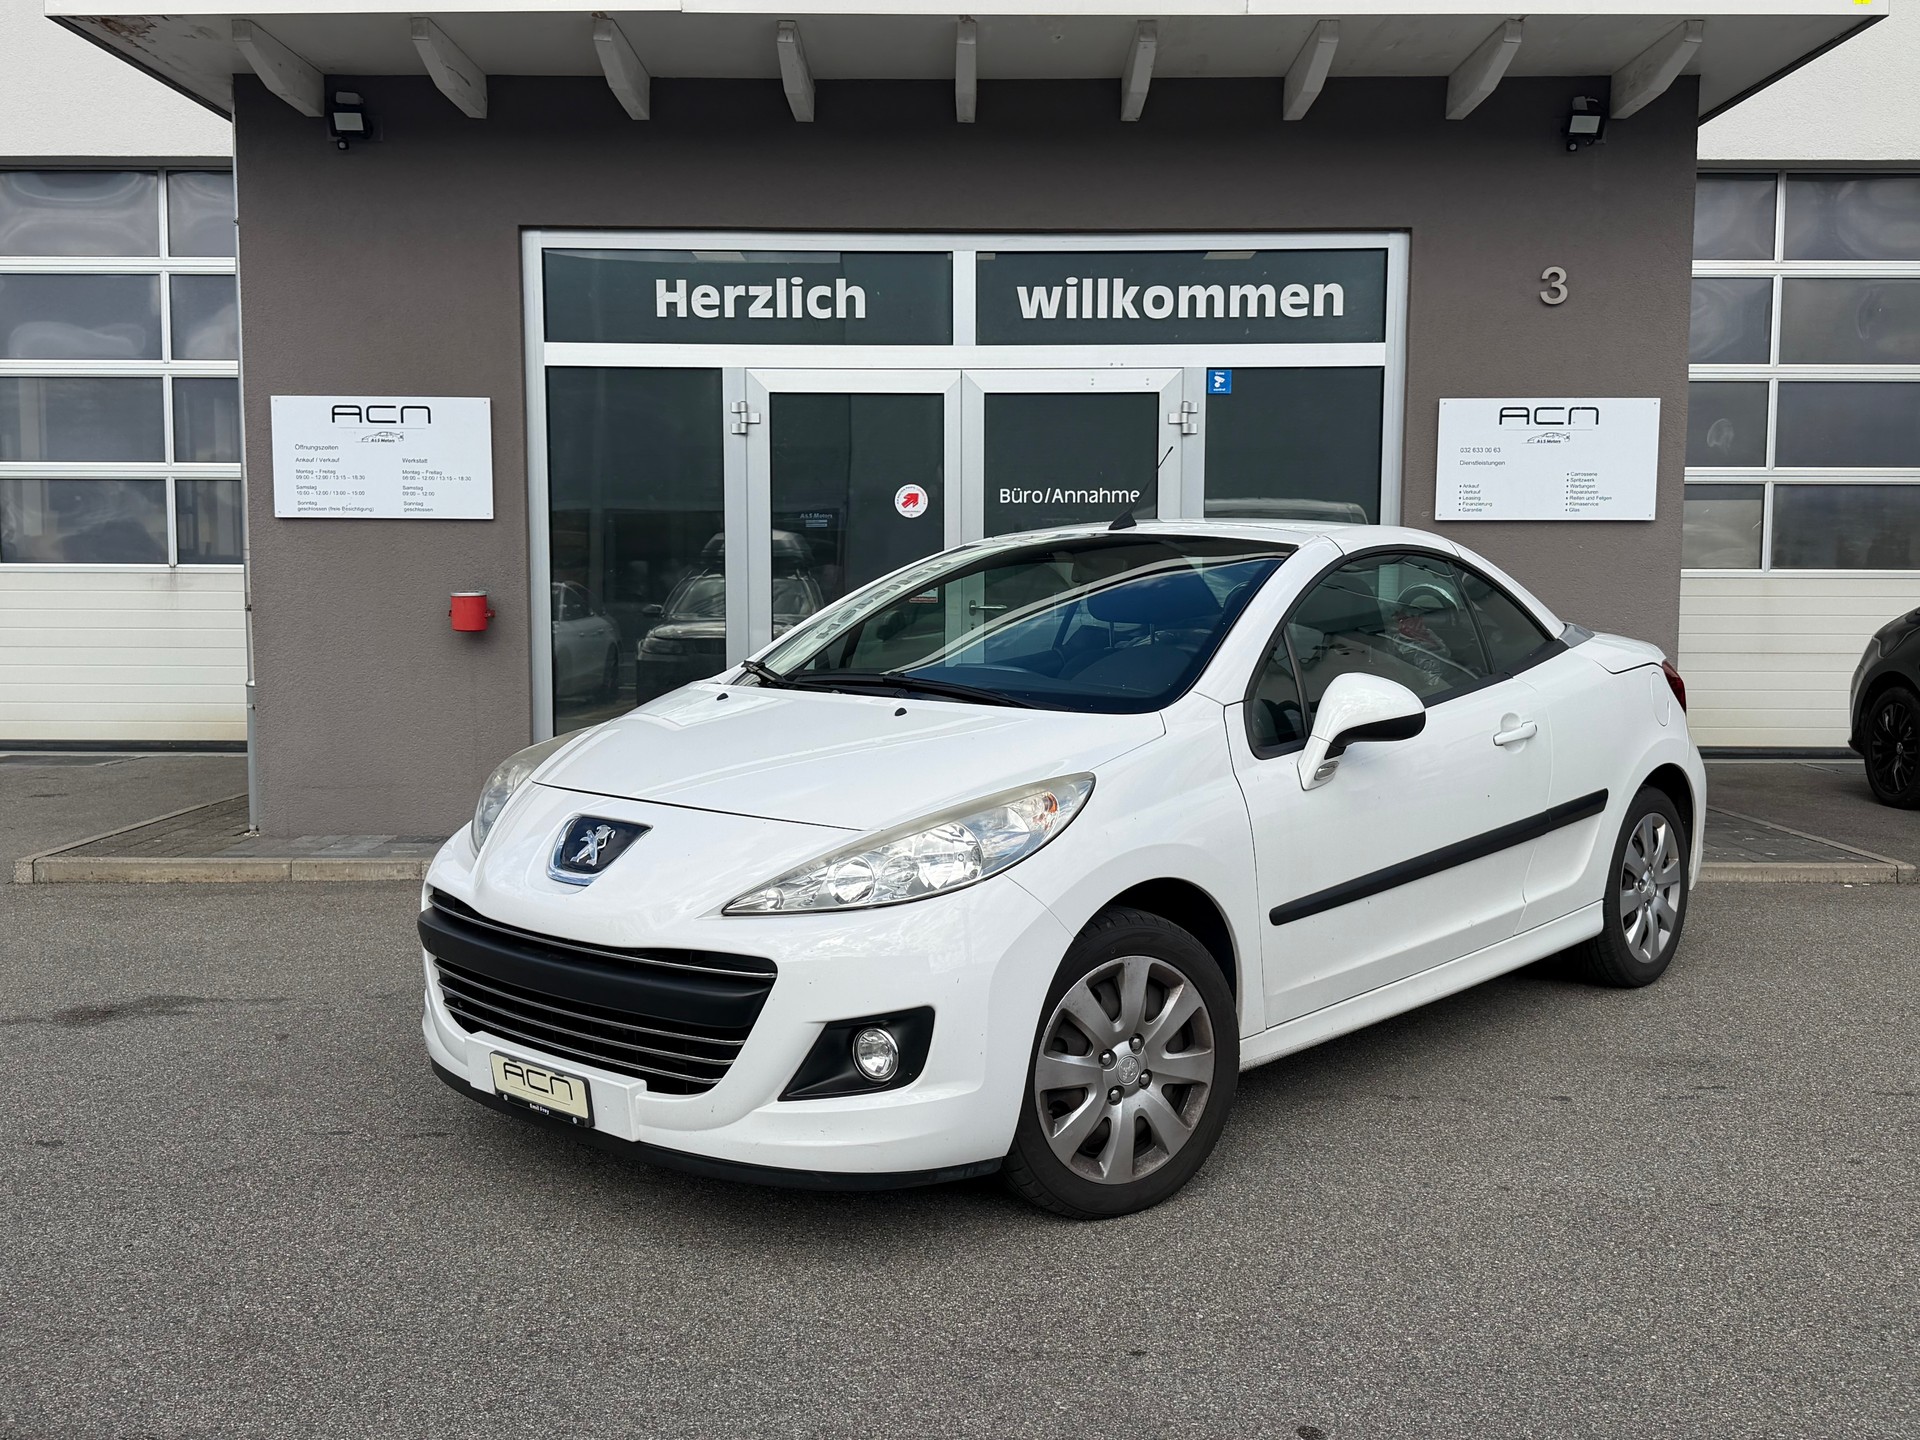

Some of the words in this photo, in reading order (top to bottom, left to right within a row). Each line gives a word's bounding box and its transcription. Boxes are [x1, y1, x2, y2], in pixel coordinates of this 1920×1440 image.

[656, 276, 866, 319] Herzlich
[1016, 276, 1344, 319] willkommen
[1540, 266, 1568, 305] 3
[294, 444, 339, 452] Öffnungszeiten
[999, 487, 1140, 504] Büro/Annahme
